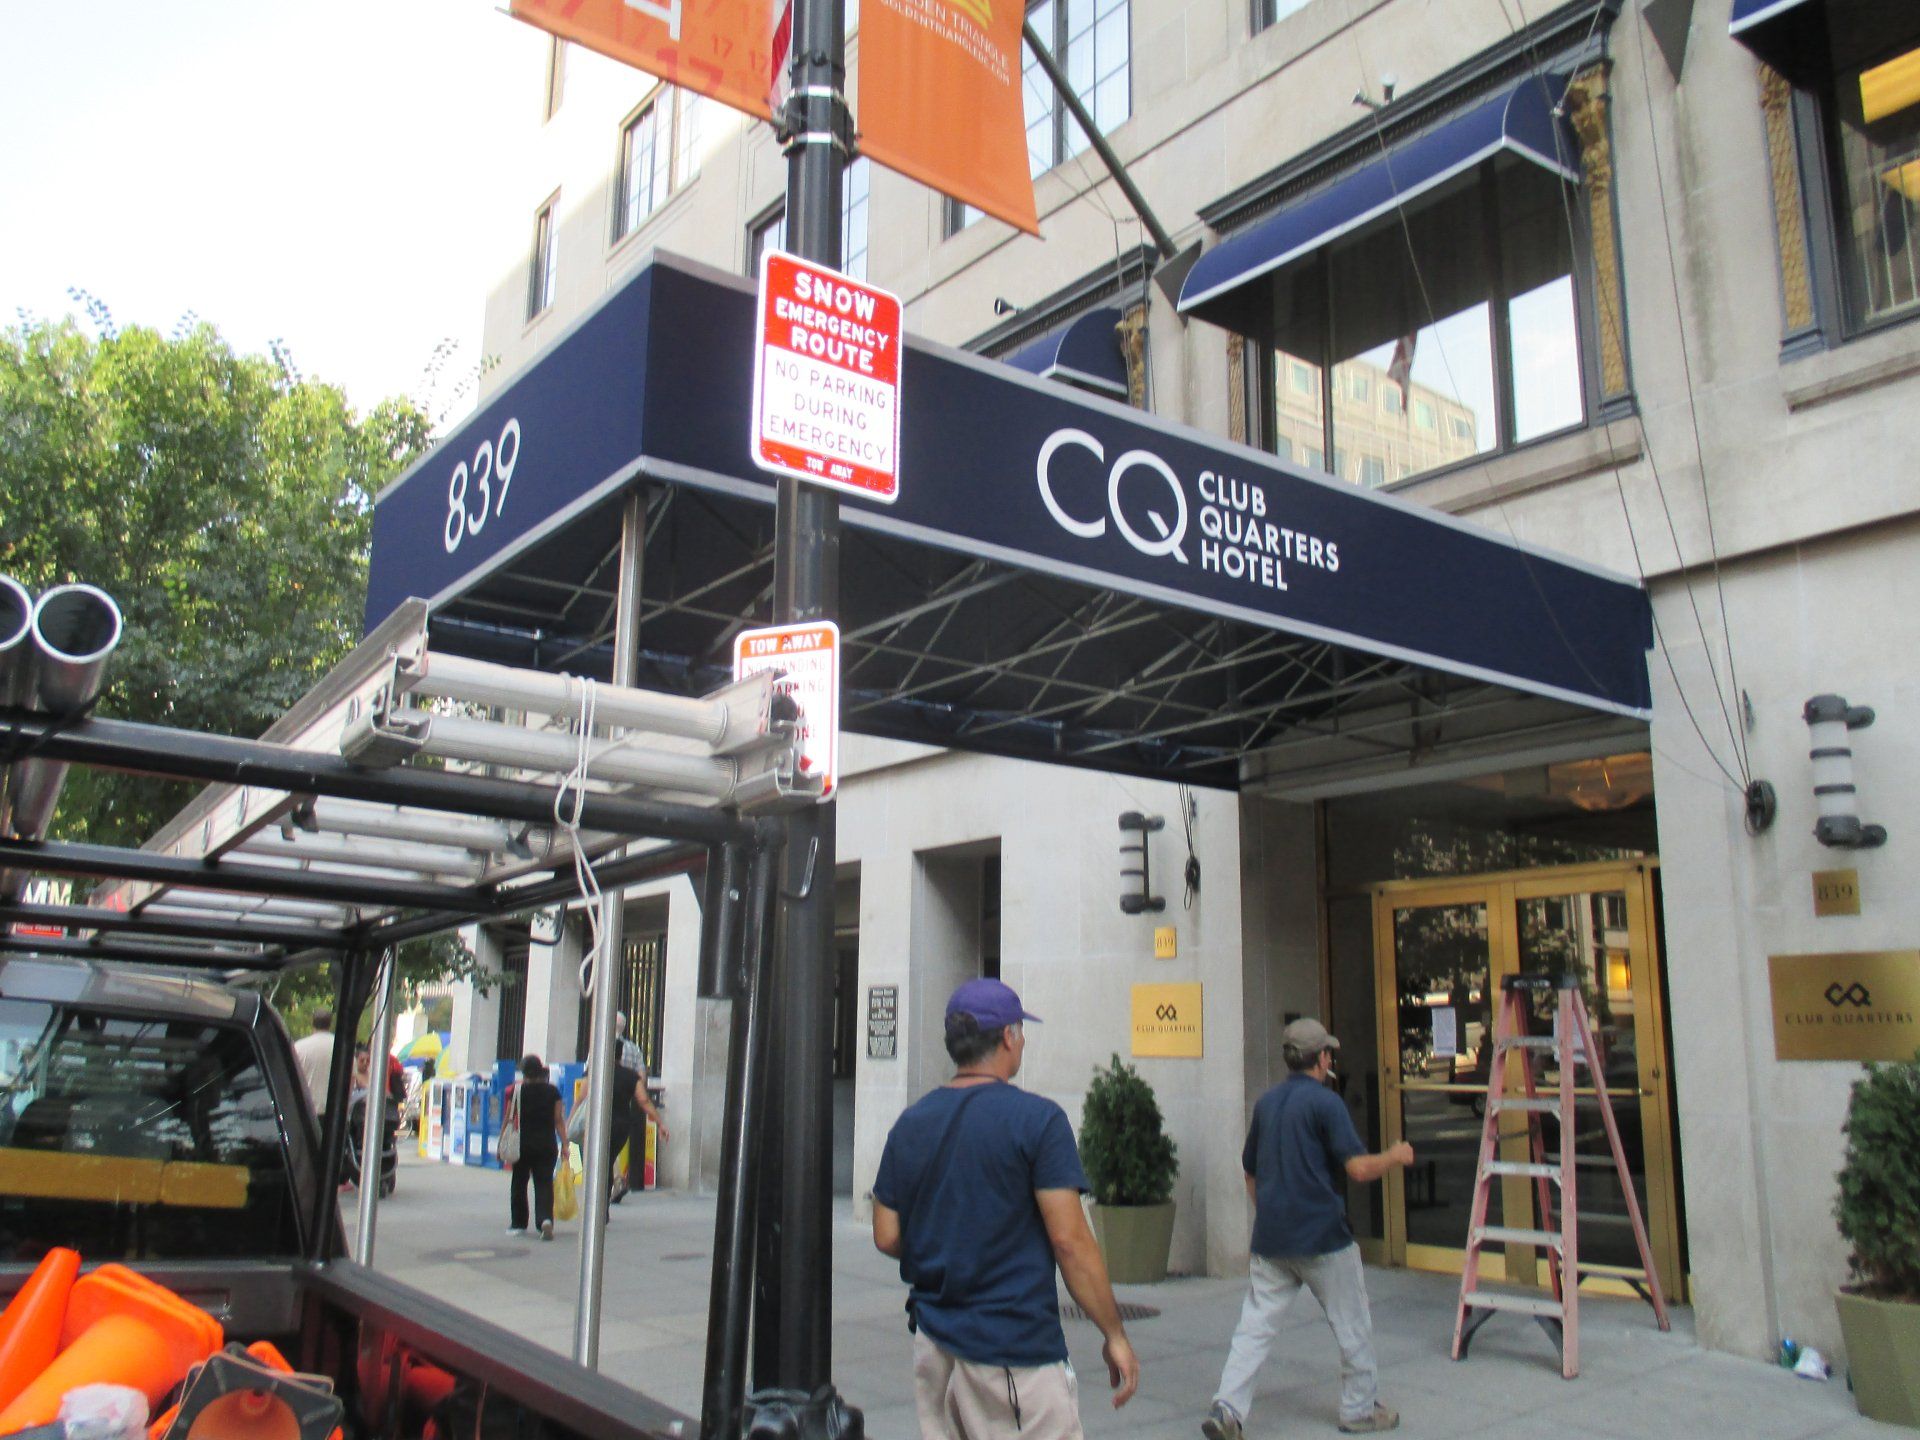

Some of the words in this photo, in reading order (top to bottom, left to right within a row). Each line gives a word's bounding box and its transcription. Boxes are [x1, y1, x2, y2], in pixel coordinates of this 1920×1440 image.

[712, 33, 734, 60] 17
[951, 10, 1009, 70] TRIANGLE
[794, 272, 876, 322] SNOW
[776, 297, 890, 351] EMERGENCY
[791, 326, 874, 373] ROUTE
[775, 360, 799, 381] NO
[810, 370, 886, 409] PARKING
[795, 393, 867, 430] DURING
[770, 415, 887, 464] EMERGENCY
[445, 417, 521, 554] 839
[806, 456, 824, 473] TOW
[830, 463, 854, 479] AWAY
[1037, 427, 1189, 565] CQ
[1198, 470, 1267, 517] CLUB
[1199, 505, 1340, 573] QUARTERS
[1201, 539, 1288, 592] HOTEL
[749, 638, 778, 655] TOW
[782, 633, 823, 650] AWAY
[1136, 1024, 1155, 1034] CLUB
[1784, 1013, 1824, 1024] CLUB
[1831, 1011, 1914, 1025] QUARTERS
